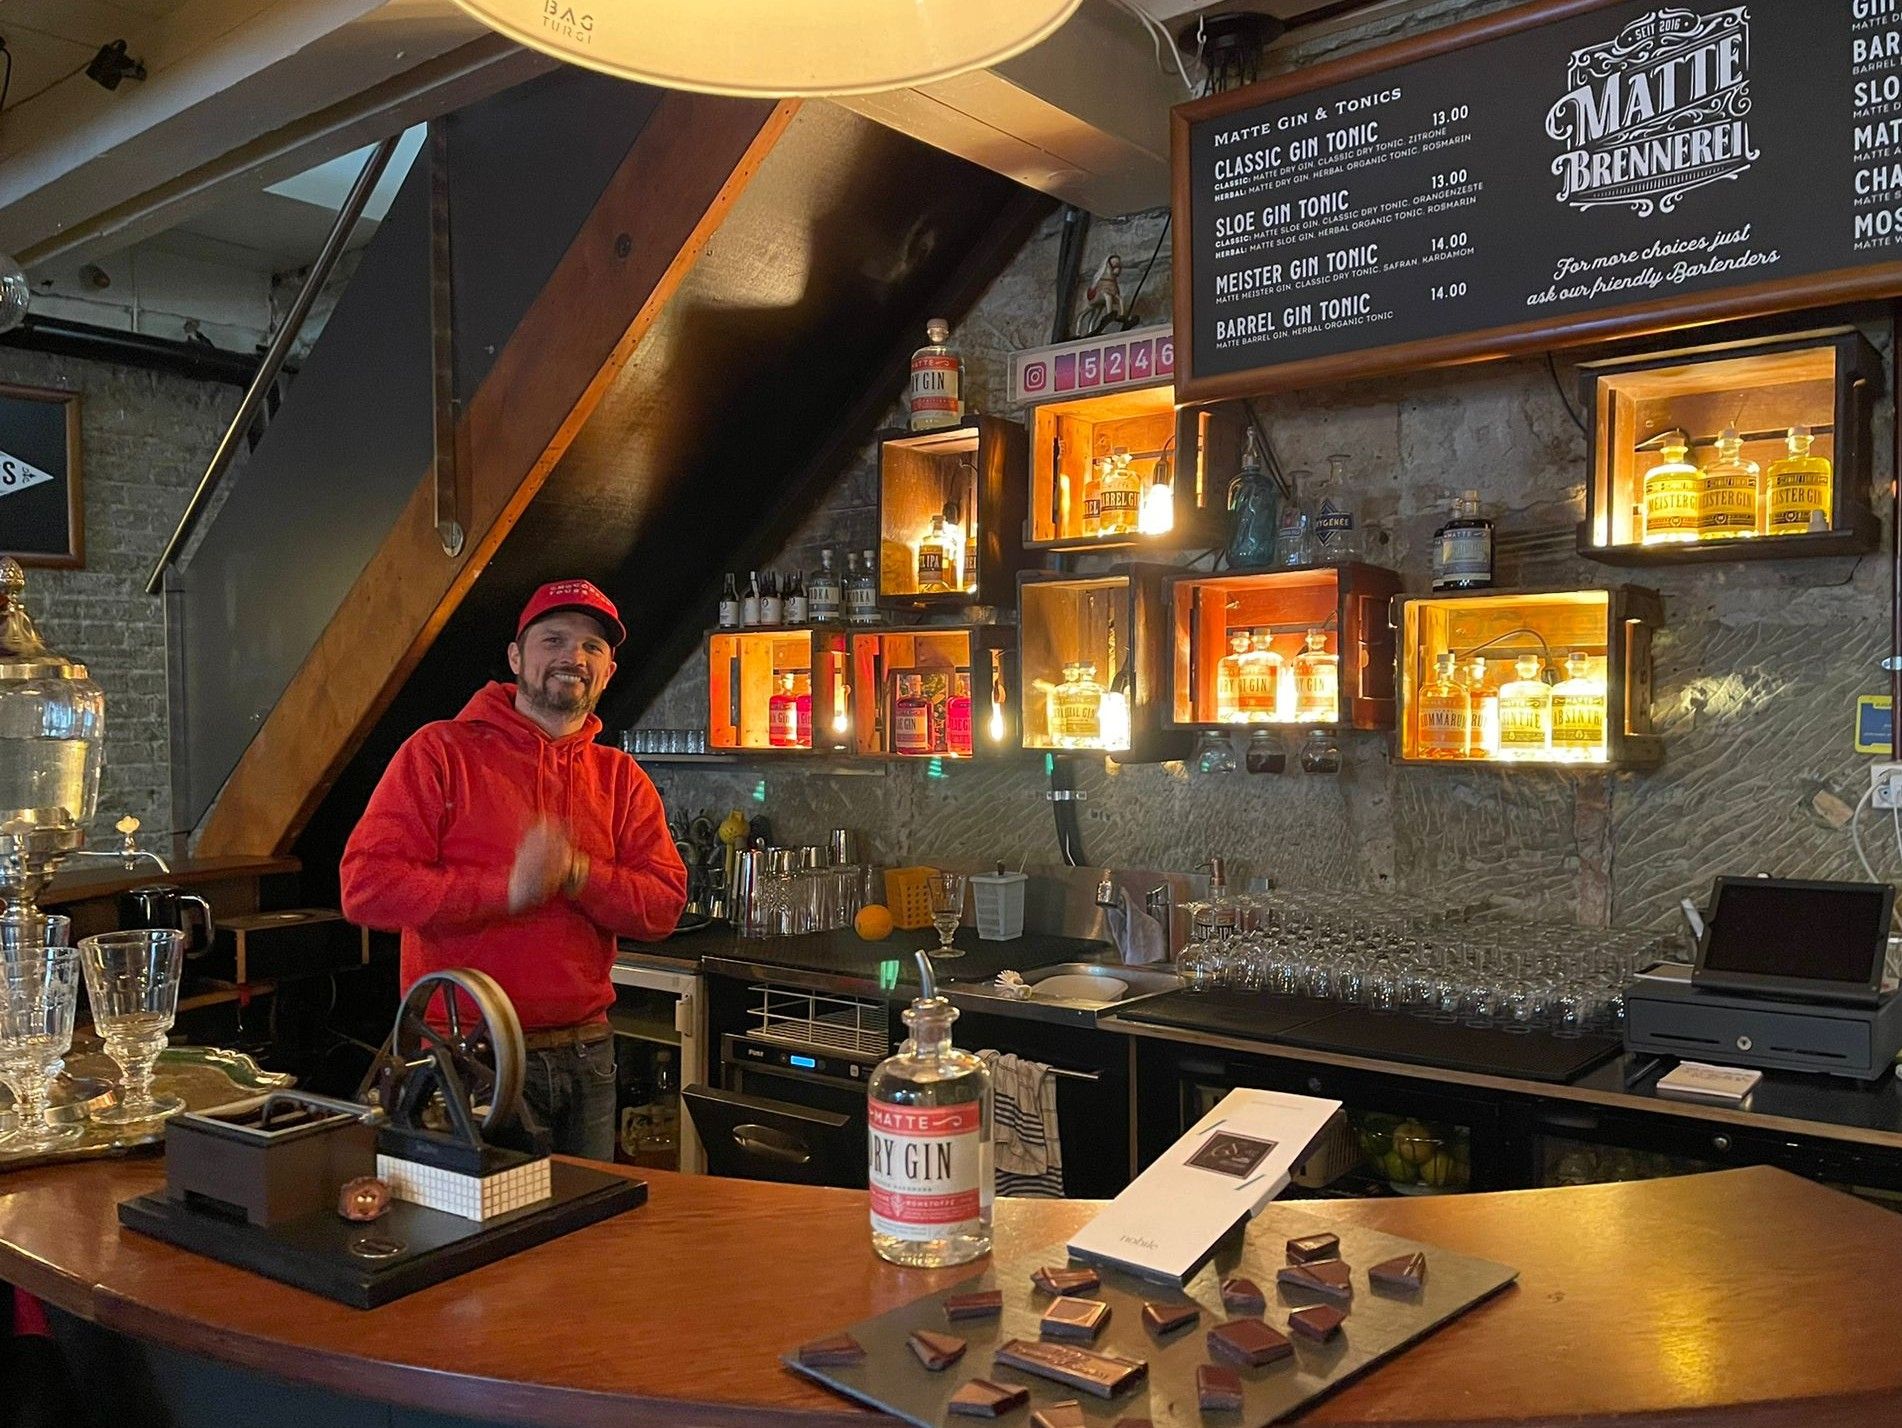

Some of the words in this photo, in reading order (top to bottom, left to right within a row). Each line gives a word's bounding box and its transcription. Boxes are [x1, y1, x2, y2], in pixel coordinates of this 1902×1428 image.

[1634, 20, 1655, 41] SEIT
[1659, 18, 1680, 33] 2016
[1852, 15, 1888, 32] MATTE
[1545, 33, 1743, 147] MATTE
[1852, 58, 1896, 76] BARREL
[1214, 122, 1271, 147] MATTE
[1277, 112, 1308, 130] GIN
[1315, 107, 1328, 120] &
[1335, 88, 1402, 114] TONICS
[1853, 103, 1888, 118] MATTE
[1214, 177, 1251, 191] CLASSIC:
[1253, 170, 1277, 182] MATTE
[1280, 165, 1296, 176] DRY
[1318, 150, 1354, 166] CLASSIC
[1356, 146, 1373, 156] DRY
[1408, 127, 1447, 144] ZITRONE
[1214, 189, 1246, 202] HERBAL:
[1248, 181, 1273, 194] MATTE
[1276, 178, 1292, 188] DRY
[1313, 166, 1344, 179] HERBAL
[1346, 154, 1388, 170] ORGANIC
[1422, 134, 1472, 152] ROSMARIN
[1215, 146, 1282, 180] CLASSIC
[1290, 136, 1318, 162] GIN
[1326, 121, 1378, 153] TONIC
[1432, 105, 1469, 126] 13.00
[1551, 120, 1744, 201] BRENNEREI
[1853, 148, 1890, 162] MATTE
[1215, 234, 1252, 248] CLASSIC:
[1254, 228, 1278, 240] MATTE
[1280, 223, 1300, 234] SLOE
[1322, 210, 1358, 225] CLASSIC
[1361, 206, 1378, 217] DRY
[1412, 182, 1484, 206] ORANGENZESTE
[1215, 247, 1248, 260] HERBAL:
[1250, 240, 1275, 252] MATTE
[1276, 235, 1297, 246] SLOE
[1318, 224, 1350, 238] HERBAL
[1352, 214, 1393, 230] ORGANIC
[1428, 196, 1477, 214] ROSMARIN
[1216, 211, 1255, 238] SLOE
[1262, 203, 1290, 228] GIN
[1298, 190, 1350, 220] TONIC
[1432, 168, 1468, 190] 13.00
[1854, 192, 1890, 207] MATTE
[1216, 264, 1282, 295] MEISTER
[1290, 256, 1318, 280] GIN
[1326, 244, 1378, 272] TONIC
[1431, 232, 1468, 252] 14.00
[1553, 256, 1591, 281] For
[1595, 250, 1638, 270] more
[1642, 235, 1709, 260] choices
[1708, 223, 1751, 252] just
[1854, 236, 1891, 251] MATTE
[1216, 293, 1240, 304] MATTE
[1242, 286, 1274, 300] MEISTER
[1295, 275, 1331, 289] CLASSIC
[1333, 270, 1350, 282] DRY
[1422, 247, 1475, 264] KARDAMOM
[1526, 288, 1558, 306] ask
[1559, 284, 1592, 300] our
[1589, 267, 1663, 300] friendly
[1666, 250, 1781, 284] Bartenders
[1216, 312, 1276, 340] BARREL
[1283, 304, 1312, 328] GIN
[1320, 293, 1370, 321] TONIC
[1431, 282, 1467, 301] 14.00
[1216, 338, 1240, 350] MATTE
[1242, 334, 1271, 346] BARREL
[1292, 324, 1322, 336] HERBAL
[1324, 316, 1364, 330] ORGANIC
[1366, 310, 1394, 322] TONIC
[922, 372, 945, 390] GIN
[874, 1110, 929, 1130] MATTE
[904, 1141, 952, 1180] GIN
